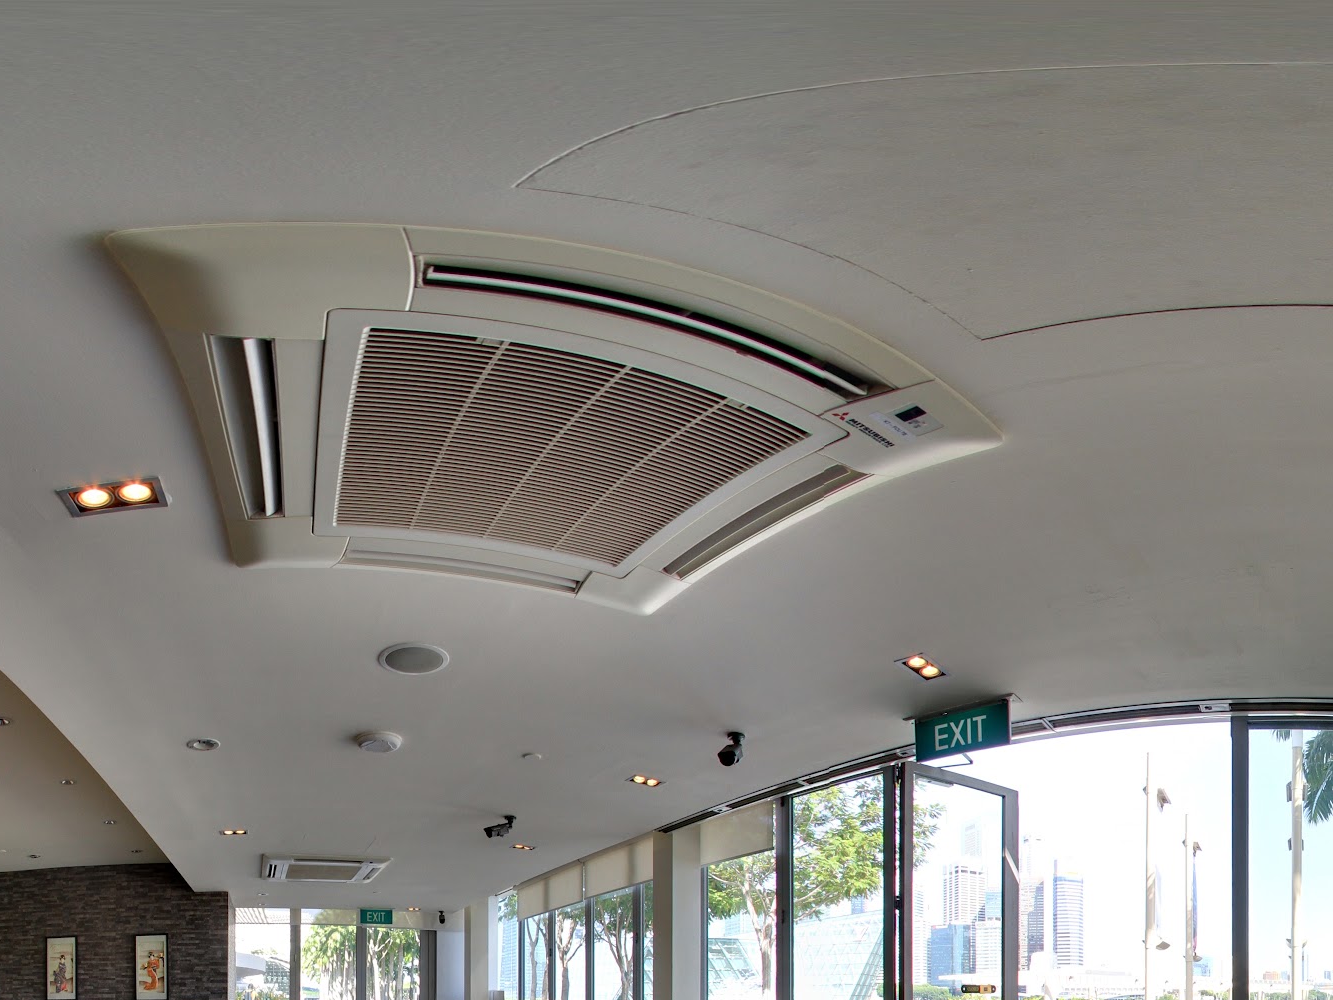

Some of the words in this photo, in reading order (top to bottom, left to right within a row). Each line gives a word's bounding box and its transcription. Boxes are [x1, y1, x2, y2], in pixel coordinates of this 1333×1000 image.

[849, 419, 895, 447] MITSUBISHI
[934, 715, 987, 751] EXIT
[366, 911, 386, 922] EXIT
